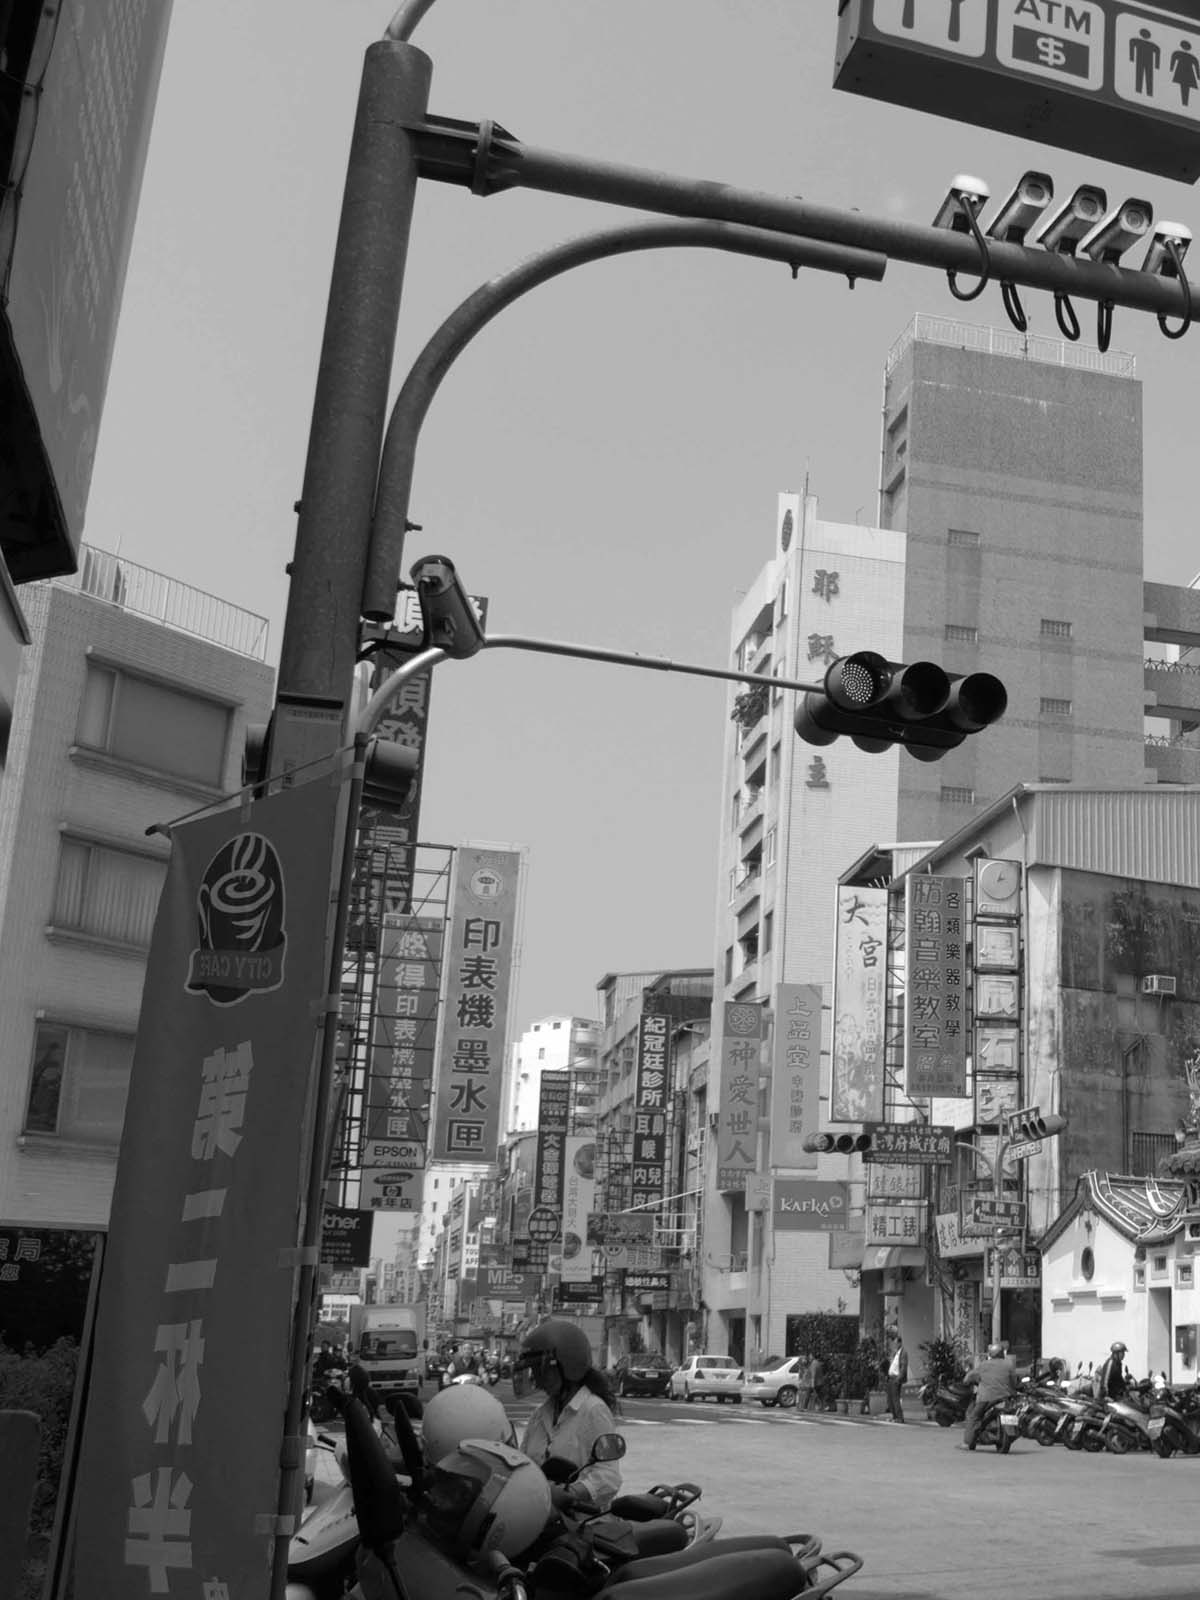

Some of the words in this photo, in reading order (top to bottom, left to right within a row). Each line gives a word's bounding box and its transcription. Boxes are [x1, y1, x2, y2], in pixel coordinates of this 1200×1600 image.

[1015, 0, 1092, 35] ATM
[805, 568, 840, 789] 耶穌主
[946, 892, 961, 1037] 各類樂器教學
[446, 917, 501, 1152] 印表機墨水匣
[641, 1016, 666, 1107] 紀冠廷診所
[786, 995, 812, 1069] 上品堂
[724, 1040, 757, 1164] 神愛世人
[374, 1145, 417, 1157] EPSON
[872, 1214, 917, 1238] 精工錶
